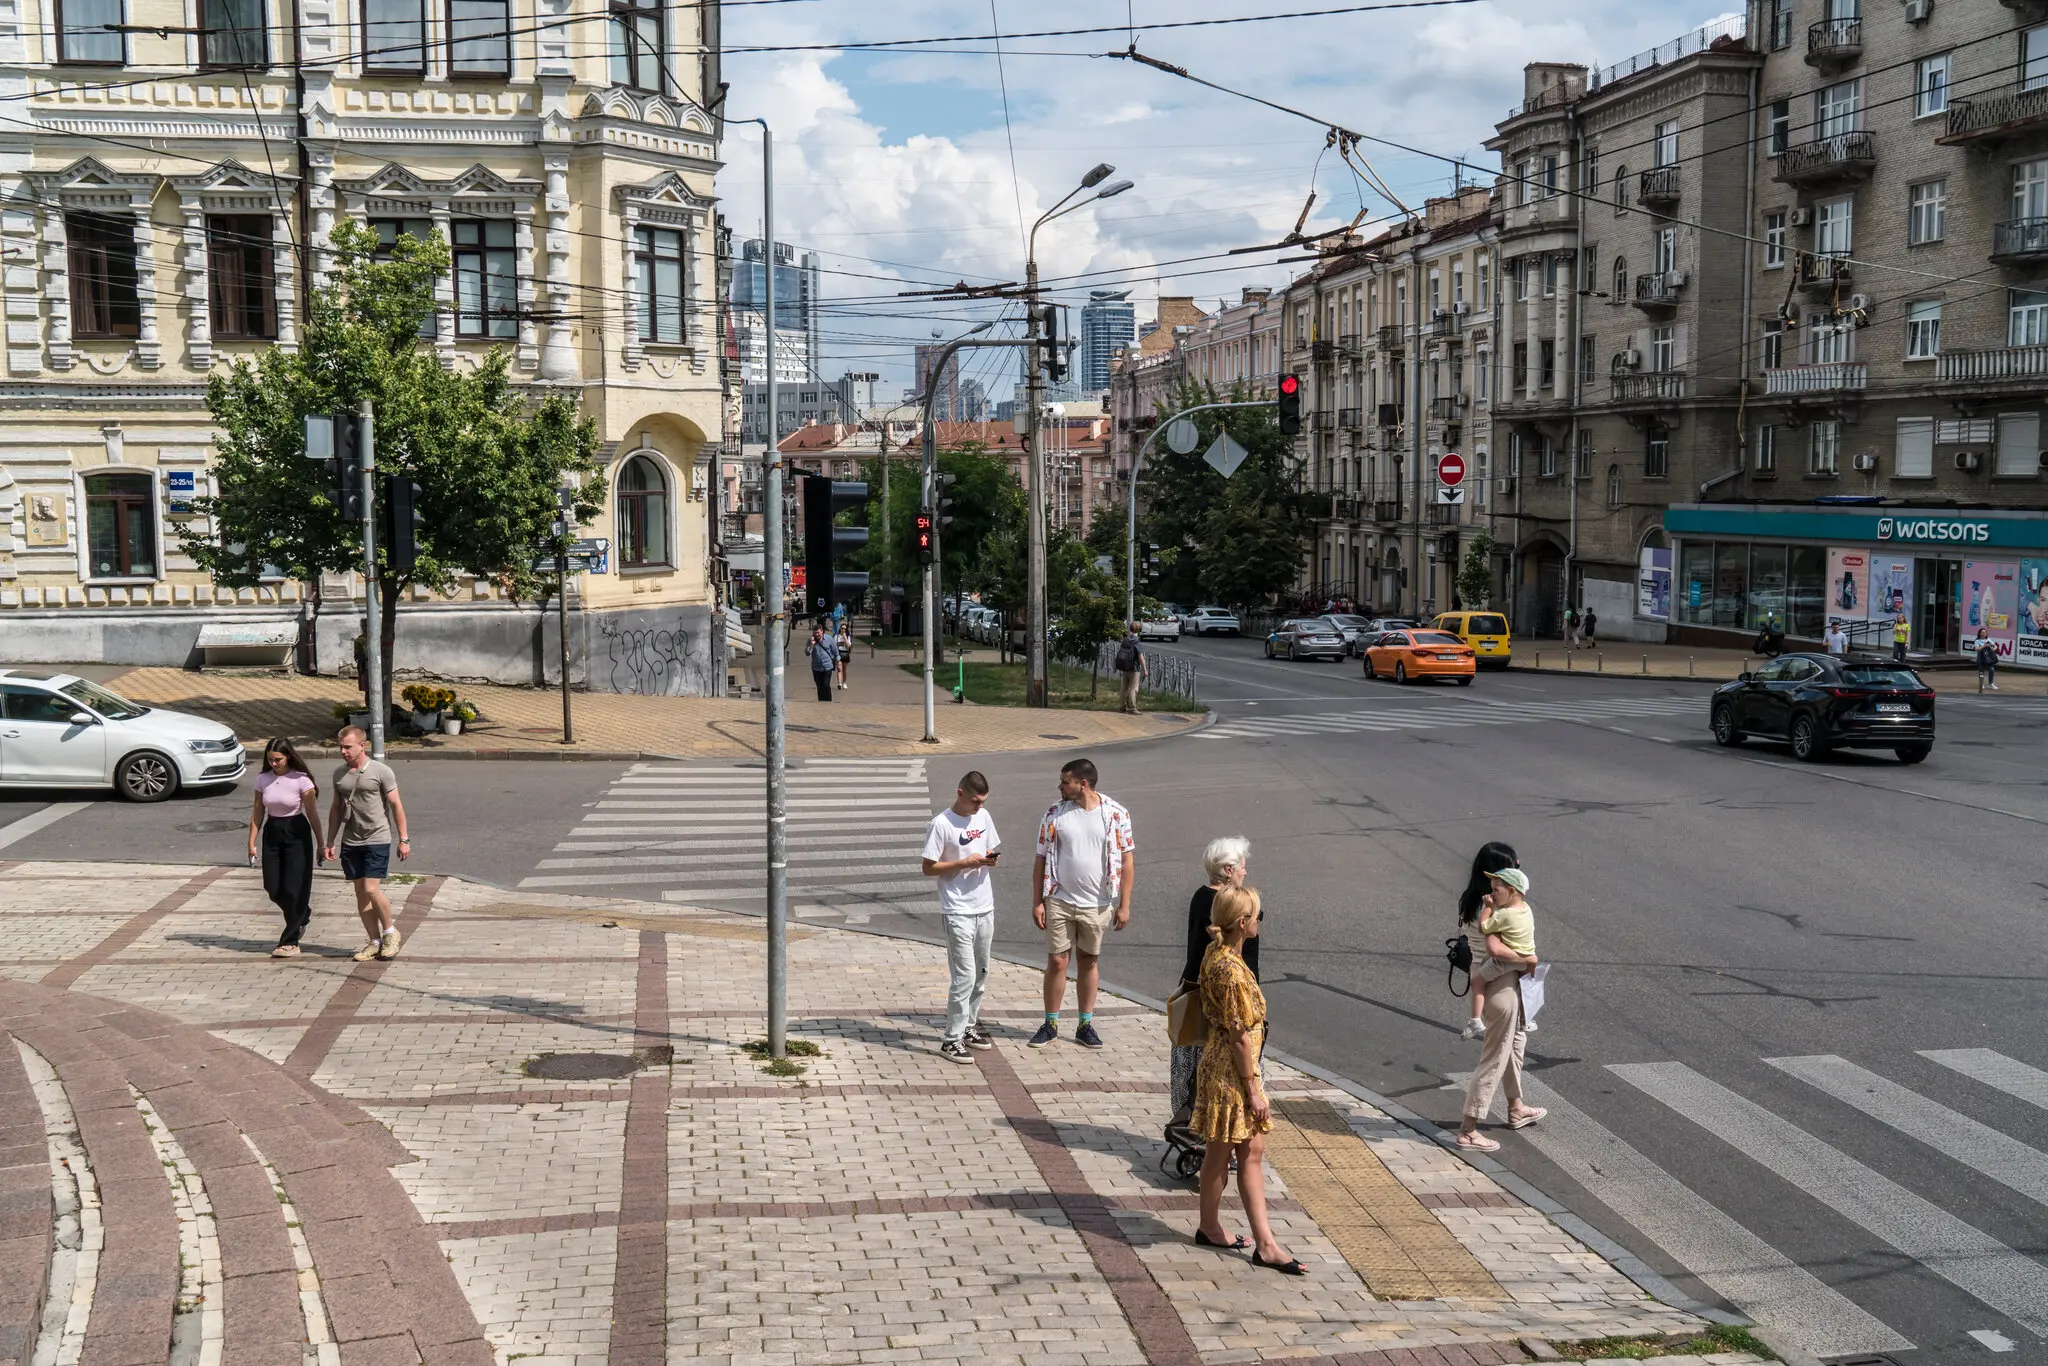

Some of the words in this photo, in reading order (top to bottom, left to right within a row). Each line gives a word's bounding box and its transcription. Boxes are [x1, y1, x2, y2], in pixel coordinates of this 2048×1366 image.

[917, 517, 930, 528] 54
[1896, 519, 1990, 541] watsons
[2020, 639, 2044, 647] КРАСА
[2033, 650, 2048, 658] ВИБ
[966, 829, 981, 841] PSG
